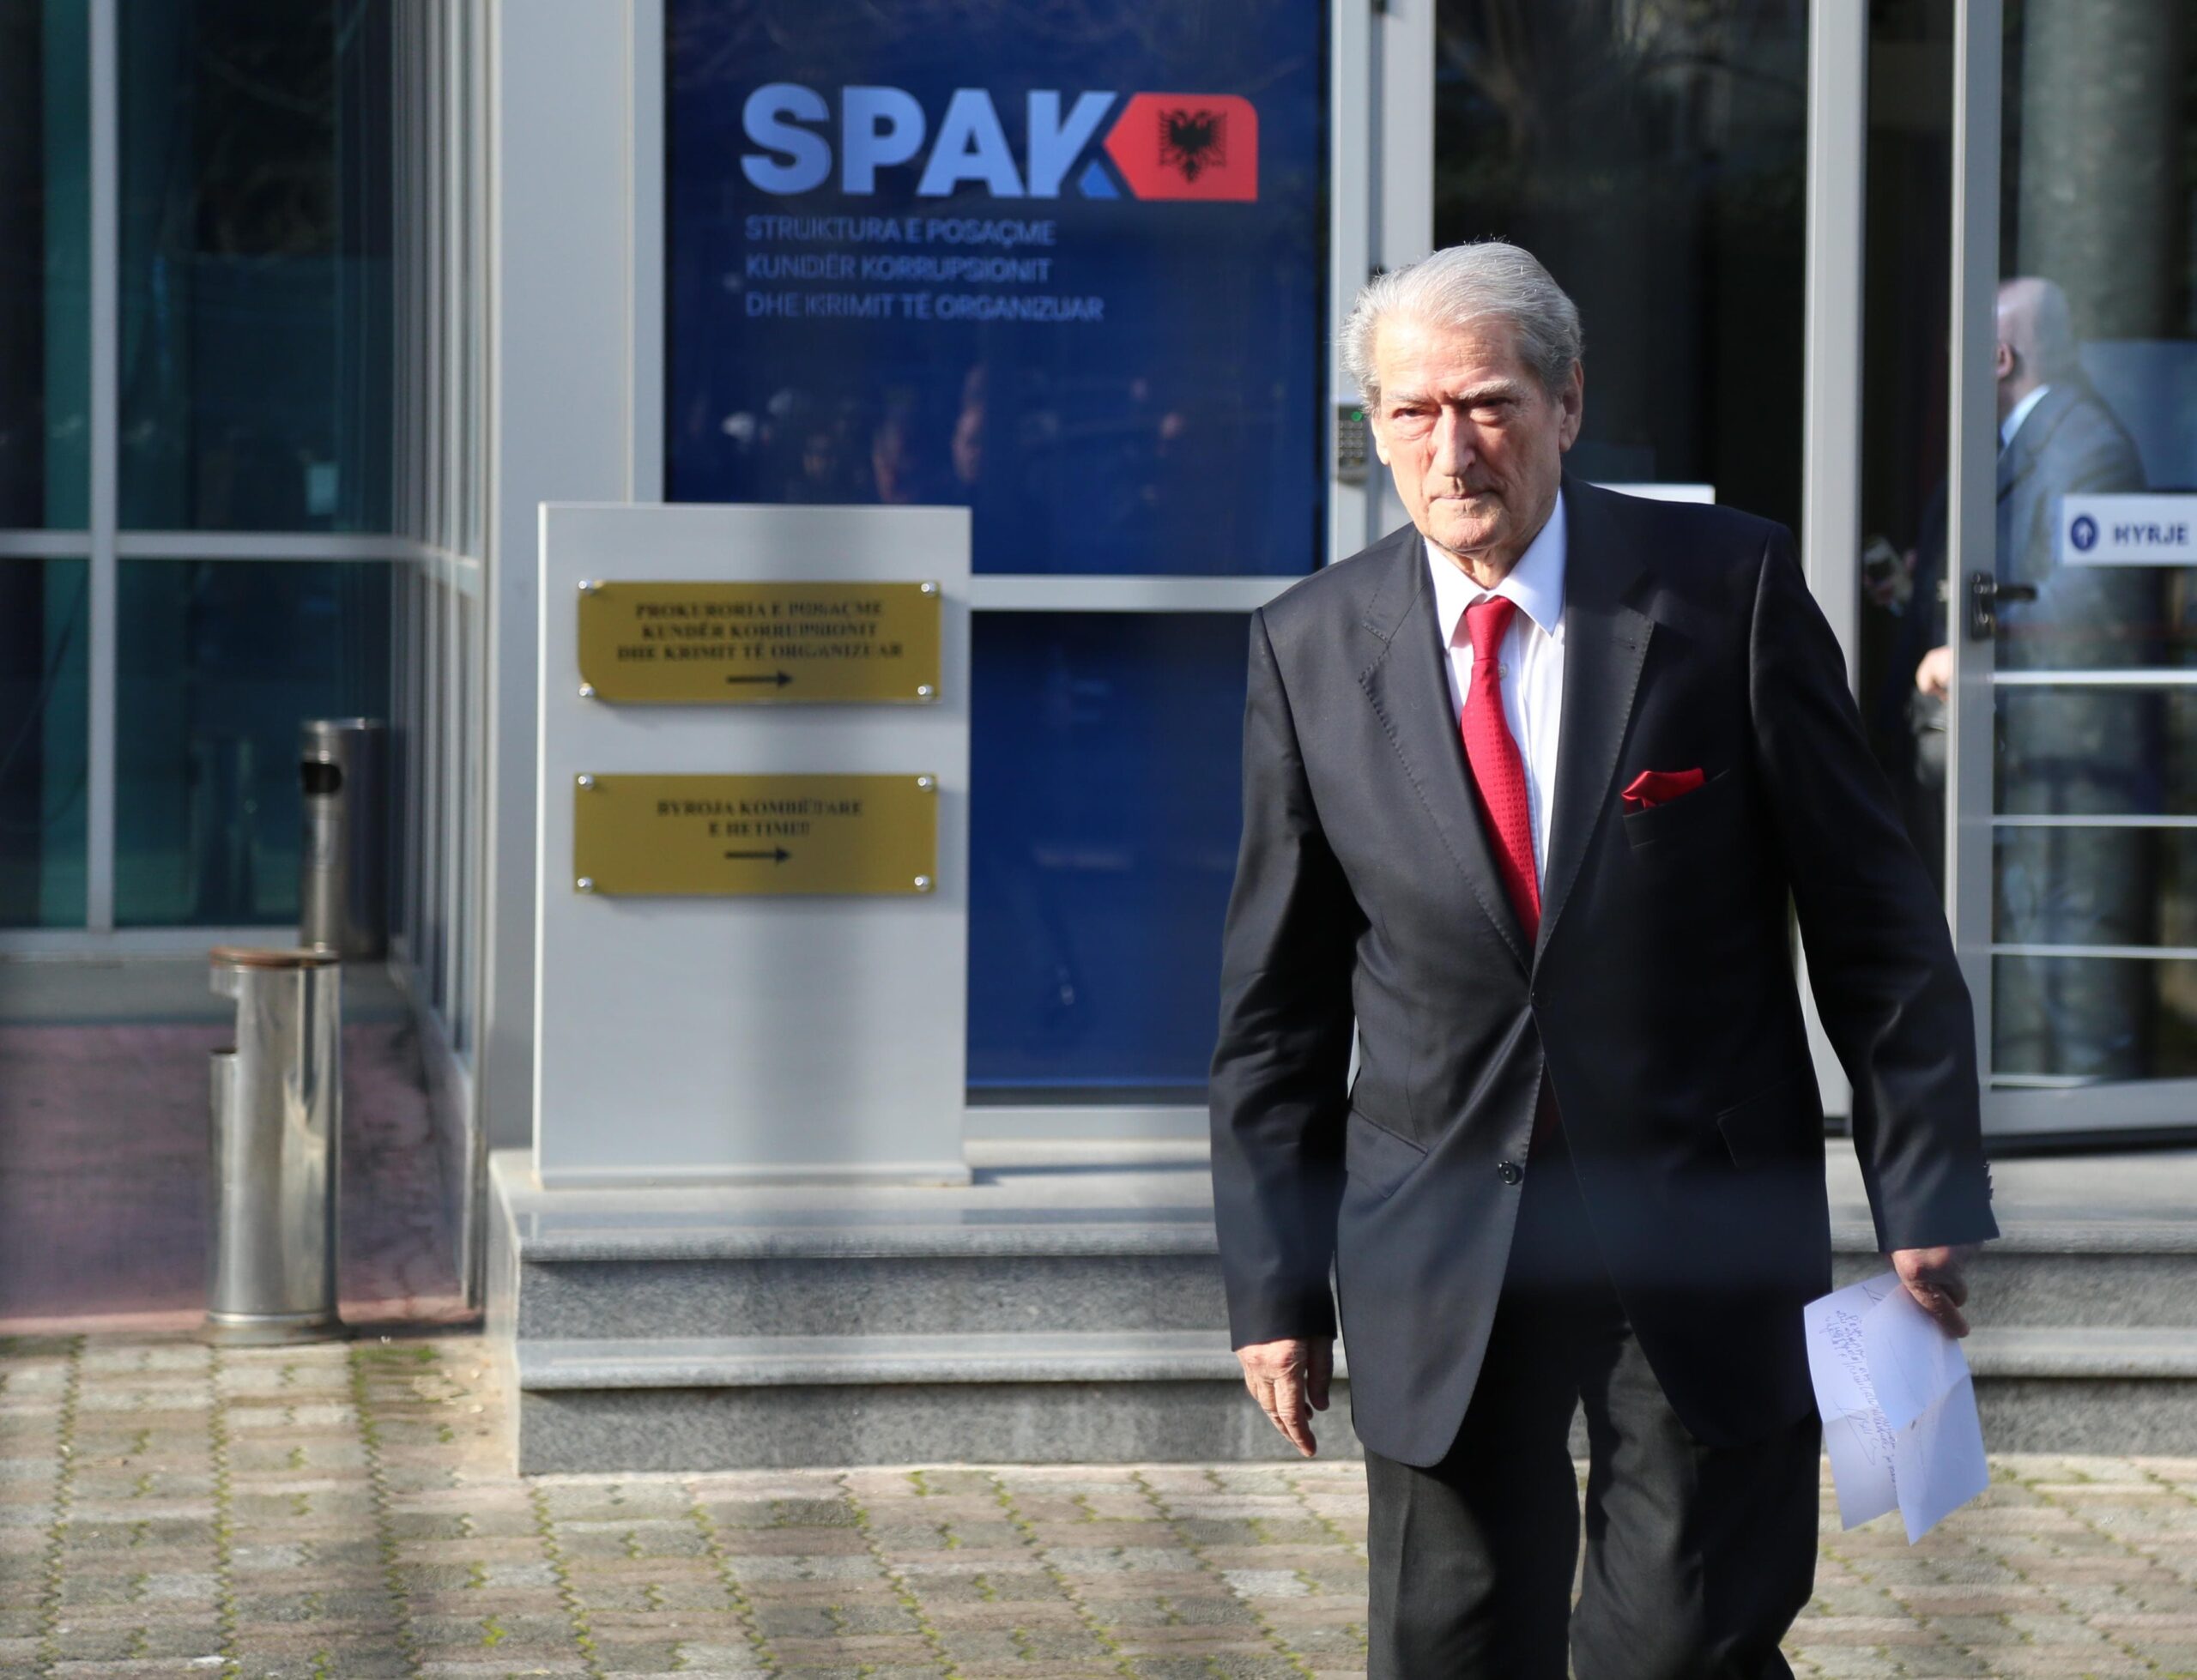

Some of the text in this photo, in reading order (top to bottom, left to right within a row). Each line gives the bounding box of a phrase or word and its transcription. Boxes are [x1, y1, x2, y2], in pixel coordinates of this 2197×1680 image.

[741, 82, 1120, 200] SPAK
[745, 215, 1056, 248] STRUKTURA E POSAÇME
[745, 252, 1051, 283] KUNDËR KORRUPSIONIT
[746, 290, 1104, 322] DHE KRIMIT TË ORGANIZUAR
[2114, 524, 2189, 545] HYRJE
[617, 645, 656, 661] DHE
[663, 644, 736, 661] KRIMIT
